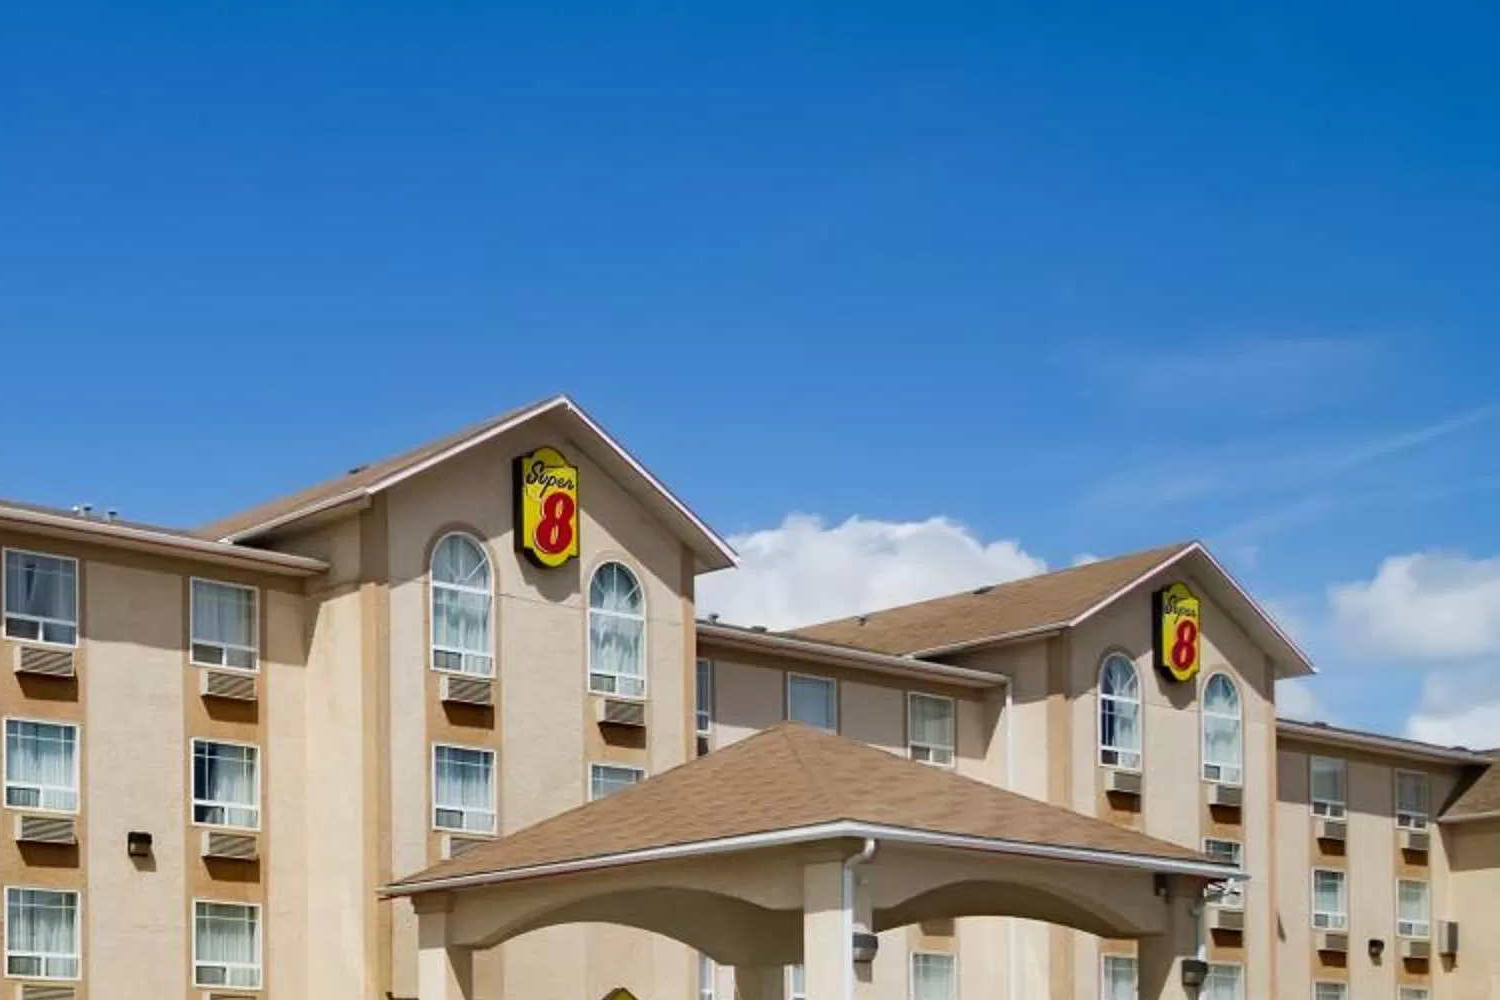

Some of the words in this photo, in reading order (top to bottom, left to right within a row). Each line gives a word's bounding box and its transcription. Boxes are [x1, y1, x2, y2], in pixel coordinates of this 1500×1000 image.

[526, 461, 574, 498] Super
[534, 491, 575, 555] 8
[1171, 619, 1197, 671] 8
